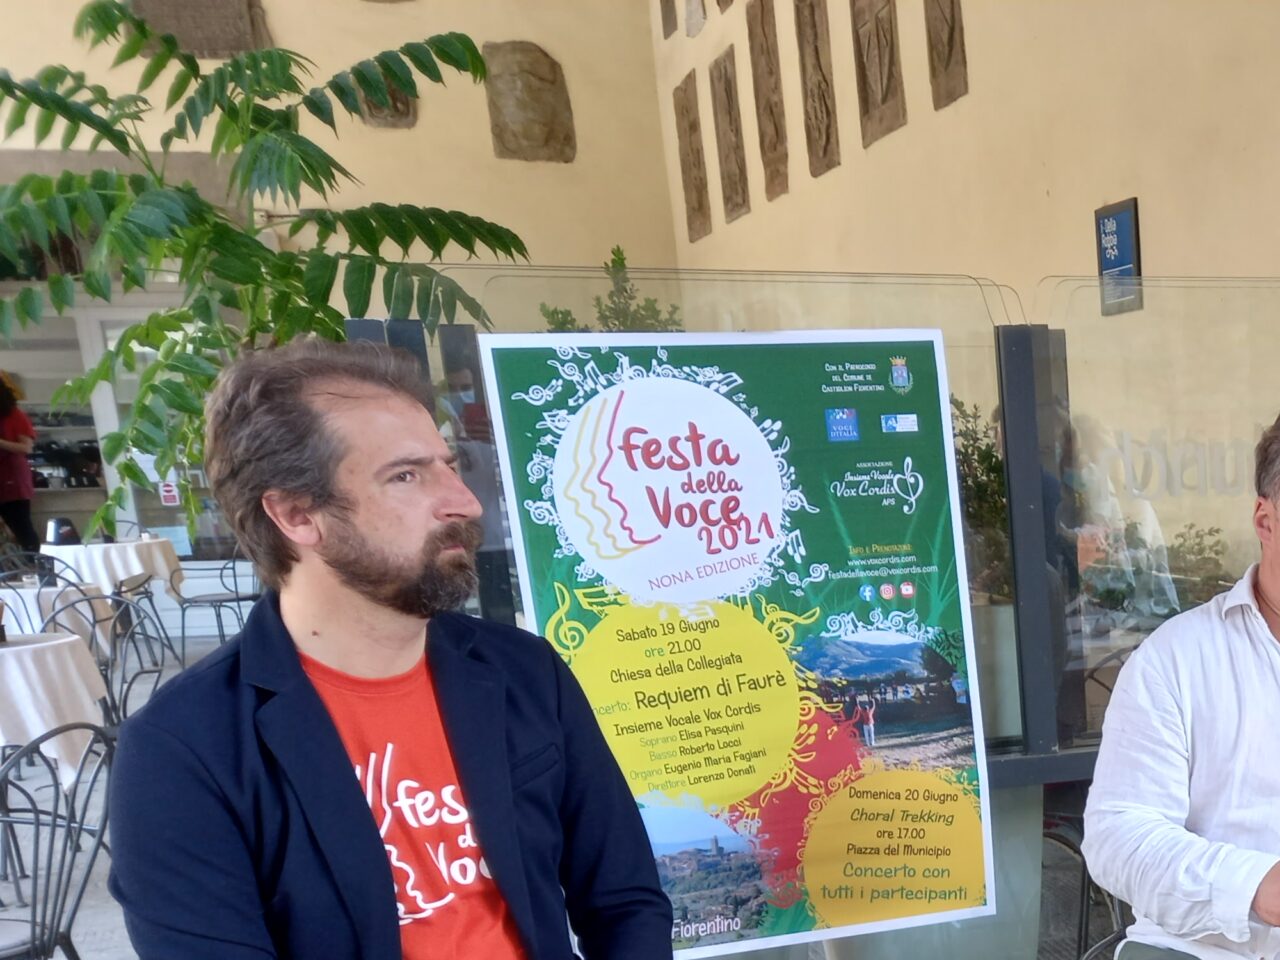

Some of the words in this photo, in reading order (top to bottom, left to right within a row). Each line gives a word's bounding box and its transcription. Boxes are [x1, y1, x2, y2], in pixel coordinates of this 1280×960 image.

[680, 471, 743, 494] della
[830, 481, 857, 497] Vox
[858, 479, 896, 496] Cordis
[645, 485, 741, 529] Voce
[698, 512, 774, 555] 2021
[847, 555, 917, 566] www.voxcordis.com
[648, 570, 694, 590] NONA
[696, 553, 759, 579] EDIZIONE
[828, 565, 938, 580] festadellavoce@voxcordis.com
[616, 626, 657, 642] Sabato
[661, 622, 675, 636] 19
[679, 618, 720, 634] Giugno
[644, 647, 665, 658] ore
[667, 638, 702, 655] 21.00
[610, 667, 651, 683] Chiesa
[655, 661, 684, 677] della
[687, 652, 743, 671] Collegiata
[593, 700, 632, 716] ncerto:
[634, 686, 710, 710] Requiem
[717, 677, 732, 697] di
[736, 670, 786, 693] Faurè
[614, 719, 663, 736] Insieme
[665, 710, 702, 727] Vocale
[703, 708, 723, 721] Vox
[725, 702, 761, 718] Cordis
[679, 727, 702, 741] Elisa
[704, 721, 744, 737] Pasquini
[679, 743, 715, 757] Roberto
[663, 759, 702, 775] Eugenio
[704, 754, 732, 768] Maria
[733, 747, 767, 764] Fagiani
[687, 771, 725, 786] Lorenzo
[727, 764, 756, 778] Donati
[392, 779, 469, 828] fes
[849, 786, 901, 801] Domenica
[905, 789, 920, 801] 20
[922, 789, 959, 805] Giugno
[850, 808, 895, 822] Choral
[900, 810, 955, 826] Trekking
[876, 828, 894, 839] ore
[897, 827, 926, 839] 17.00
[846, 843, 880, 856] Piazza
[883, 843, 899, 856] del
[903, 844, 951, 859] Municipio
[843, 862, 917, 879] Concerto
[922, 867, 951, 879] con
[820, 884, 854, 899] tutti
[870, 885, 967, 903] partecipanti
[671, 915, 741, 939] Fiorentino
